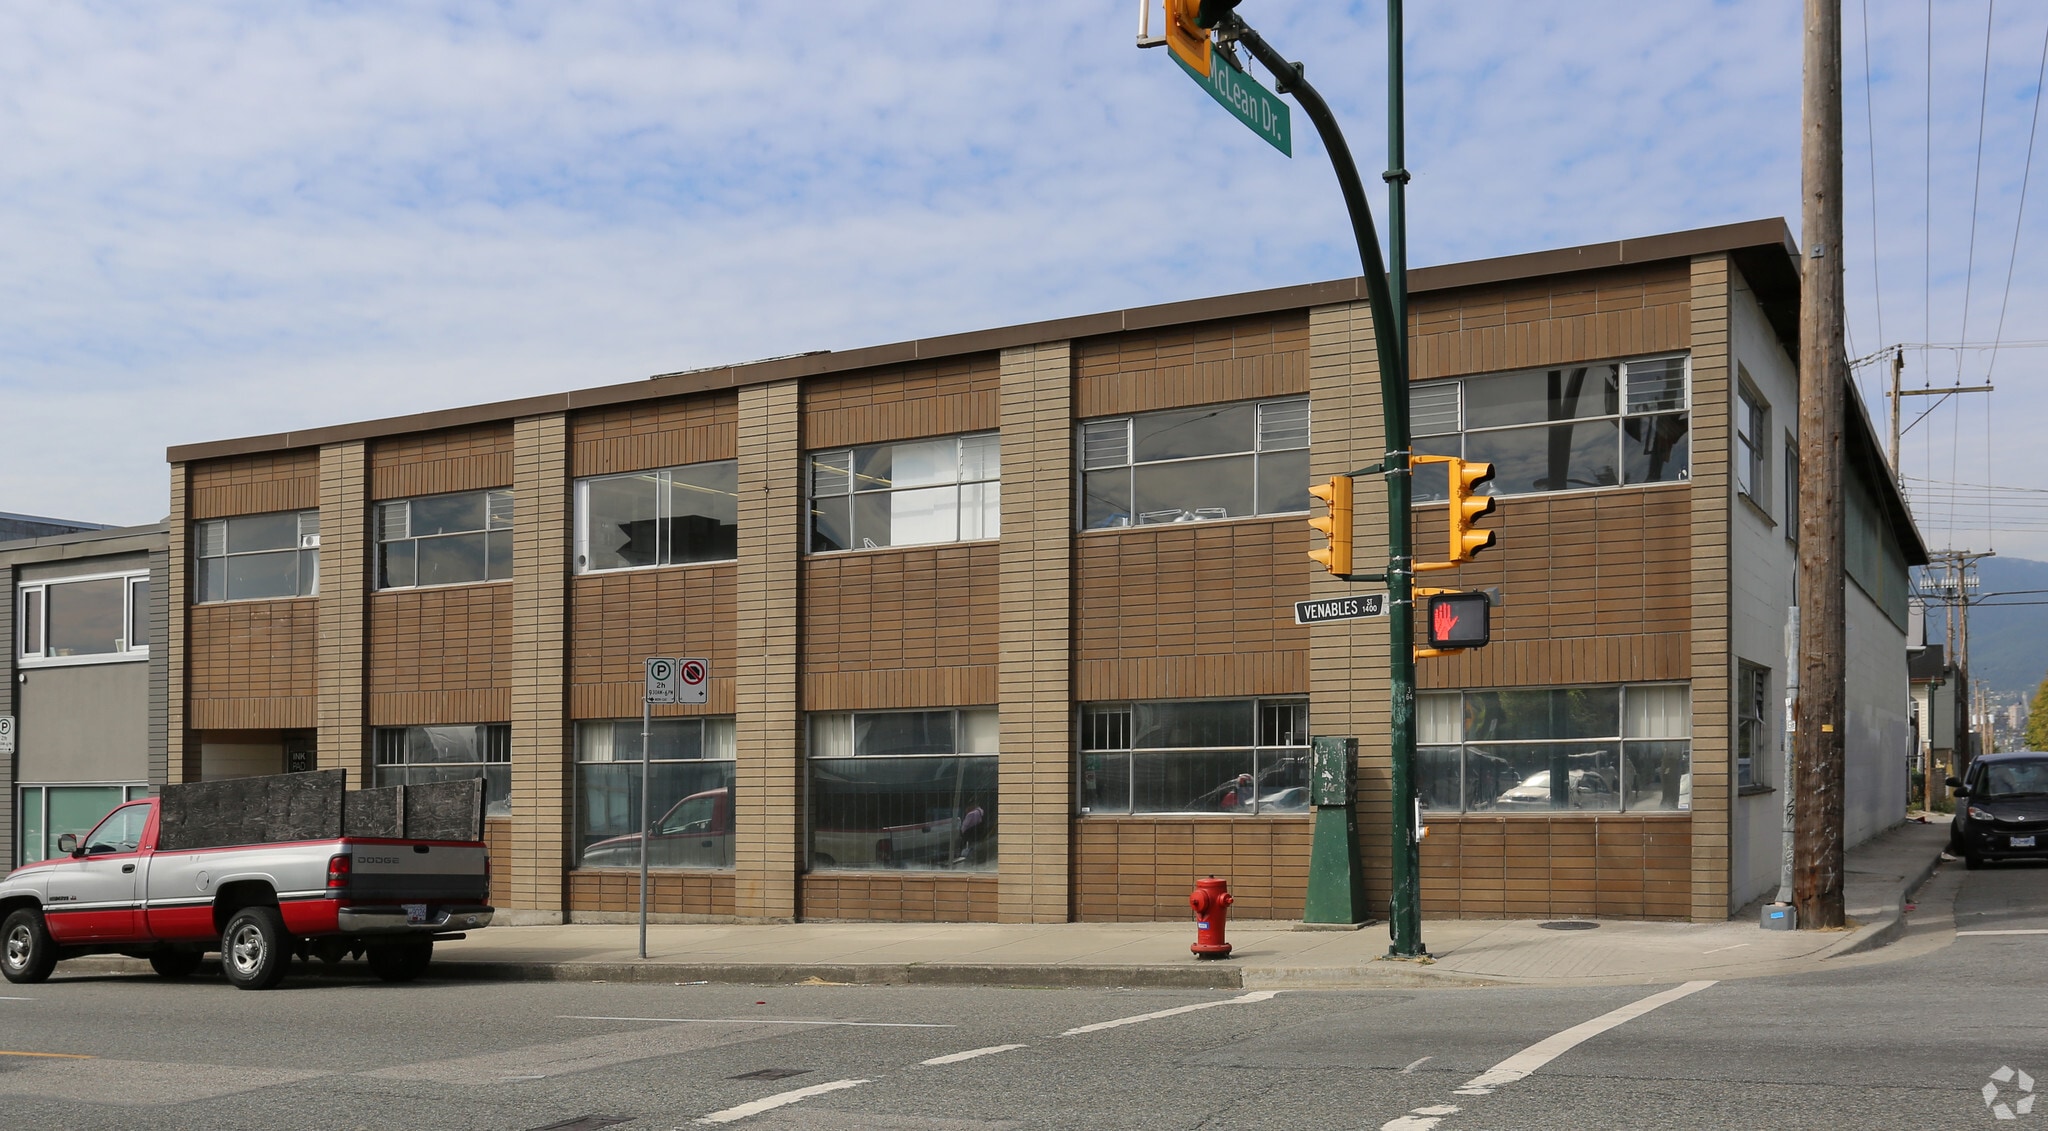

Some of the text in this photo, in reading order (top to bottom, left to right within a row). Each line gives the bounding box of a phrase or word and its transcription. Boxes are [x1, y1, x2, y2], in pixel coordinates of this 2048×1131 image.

[1208, 54, 1282, 142] McLean Dr.
[1366, 598, 1373, 606] ST
[1303, 600, 1378, 620] VENABLES 1400
[657, 665, 667, 676] P
[2, 722, 8, 731] P
[293, 752, 305, 760] INK
[293, 761, 305, 771] PAD
